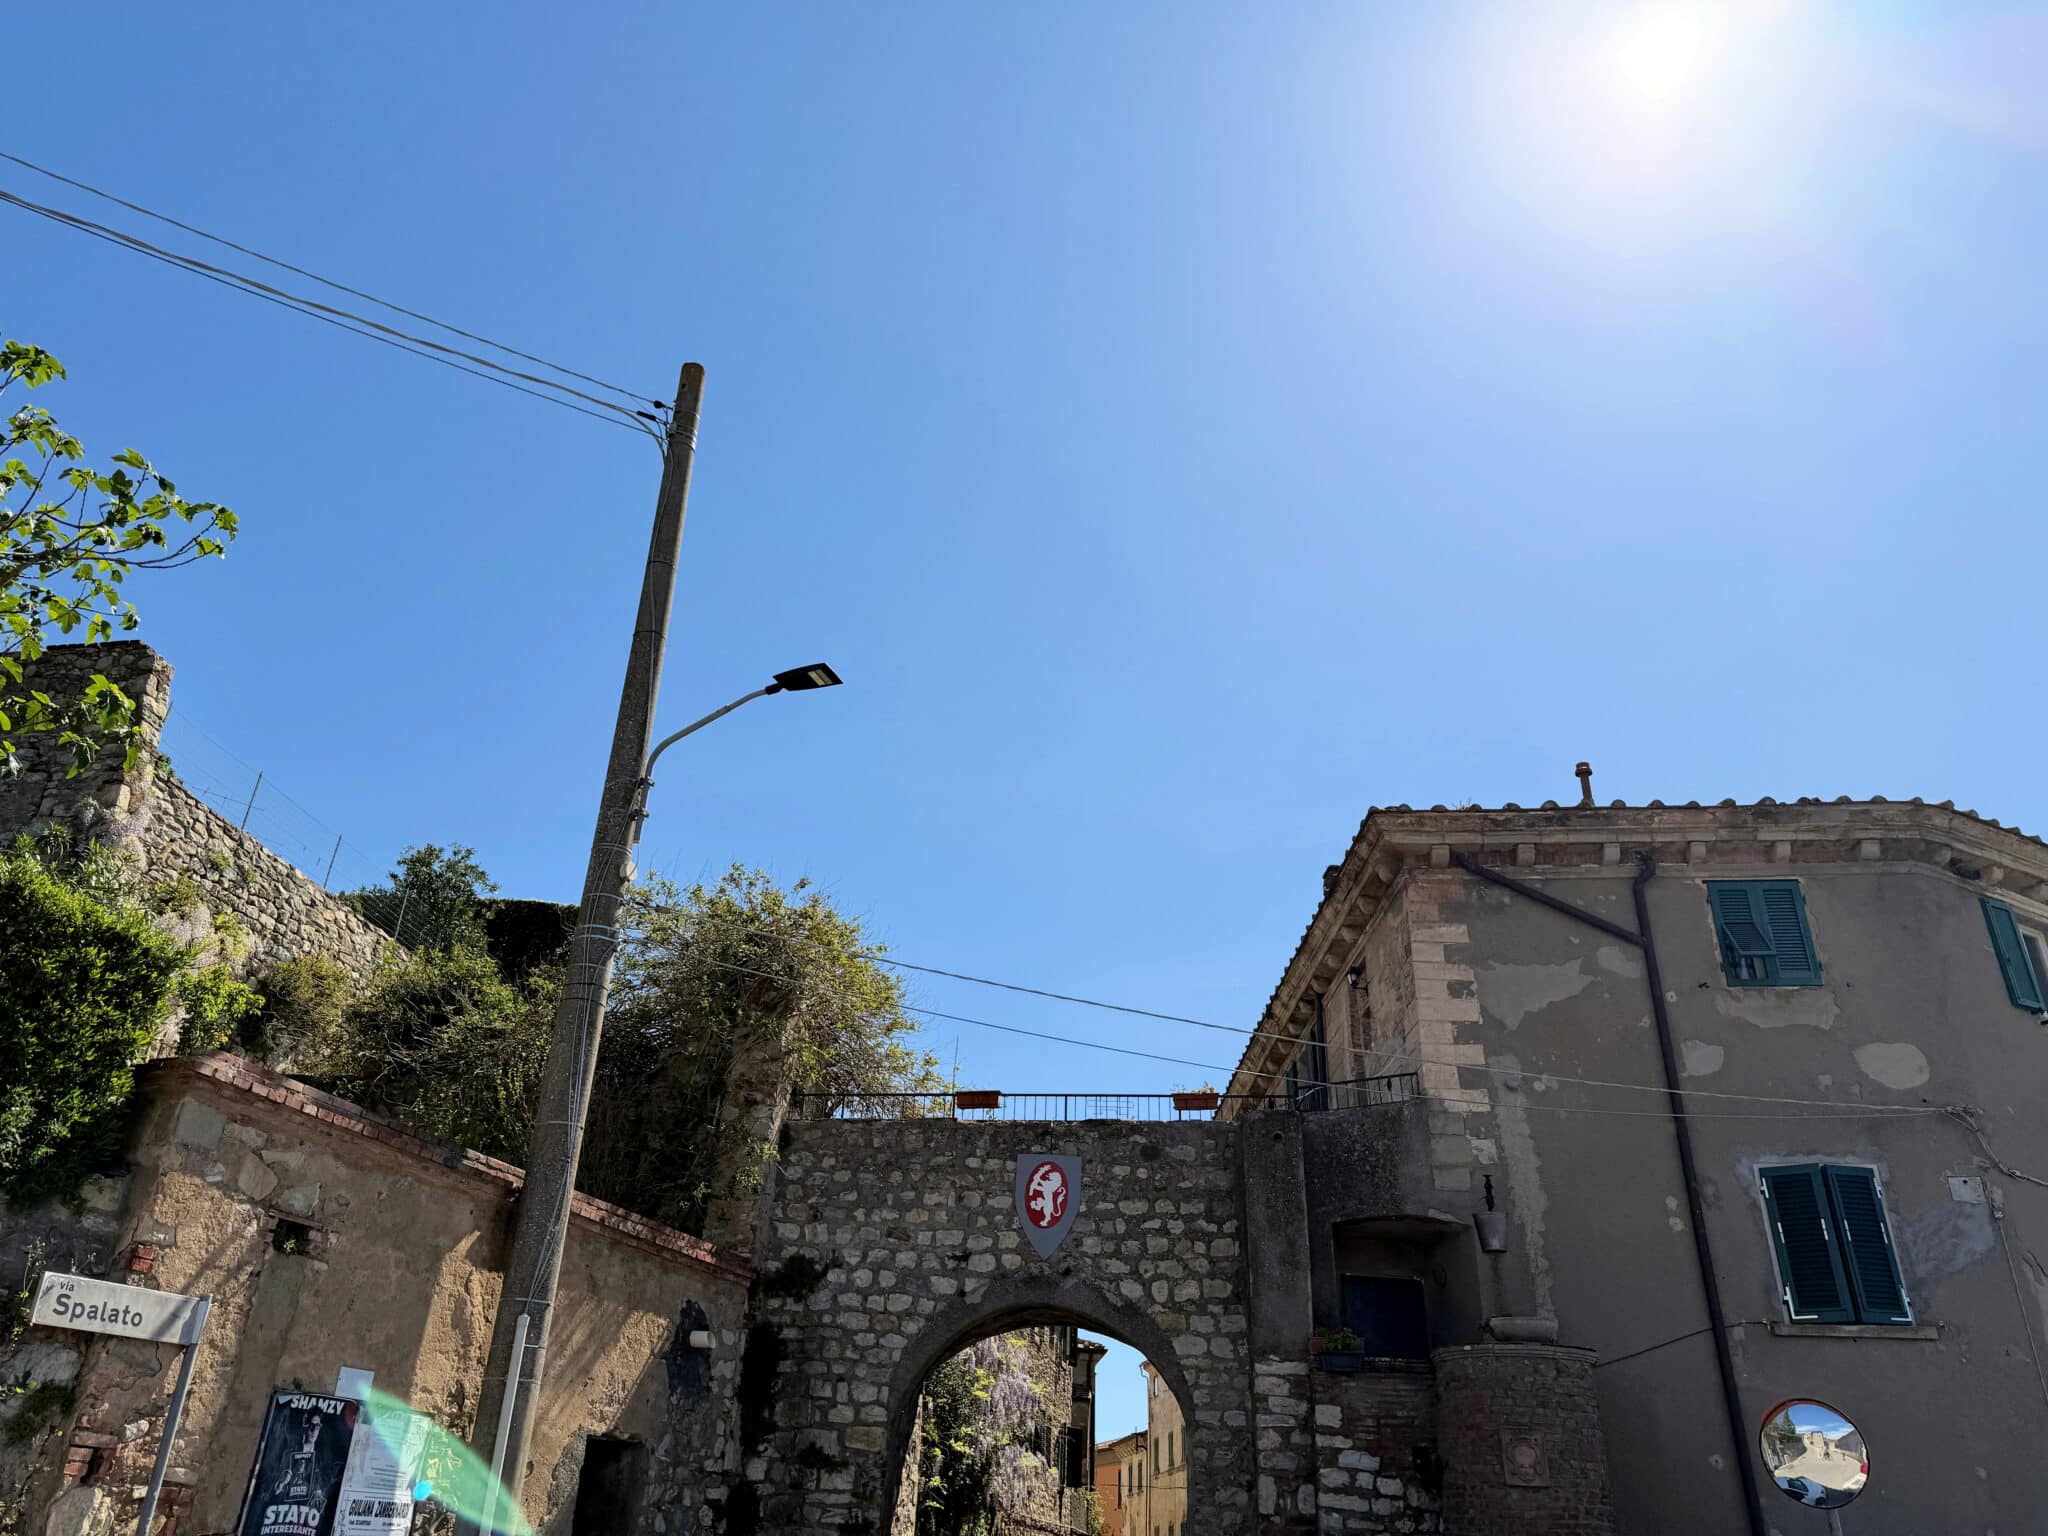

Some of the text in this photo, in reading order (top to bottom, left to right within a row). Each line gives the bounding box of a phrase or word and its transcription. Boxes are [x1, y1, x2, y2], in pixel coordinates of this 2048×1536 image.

[60, 1279, 75, 1292] via
[52, 1292, 144, 1327] Spalato
[290, 1395, 345, 1415] SHAMZY
[263, 1504, 321, 1528] STATO
[260, 1524, 317, 1536] INTERESSANTE
